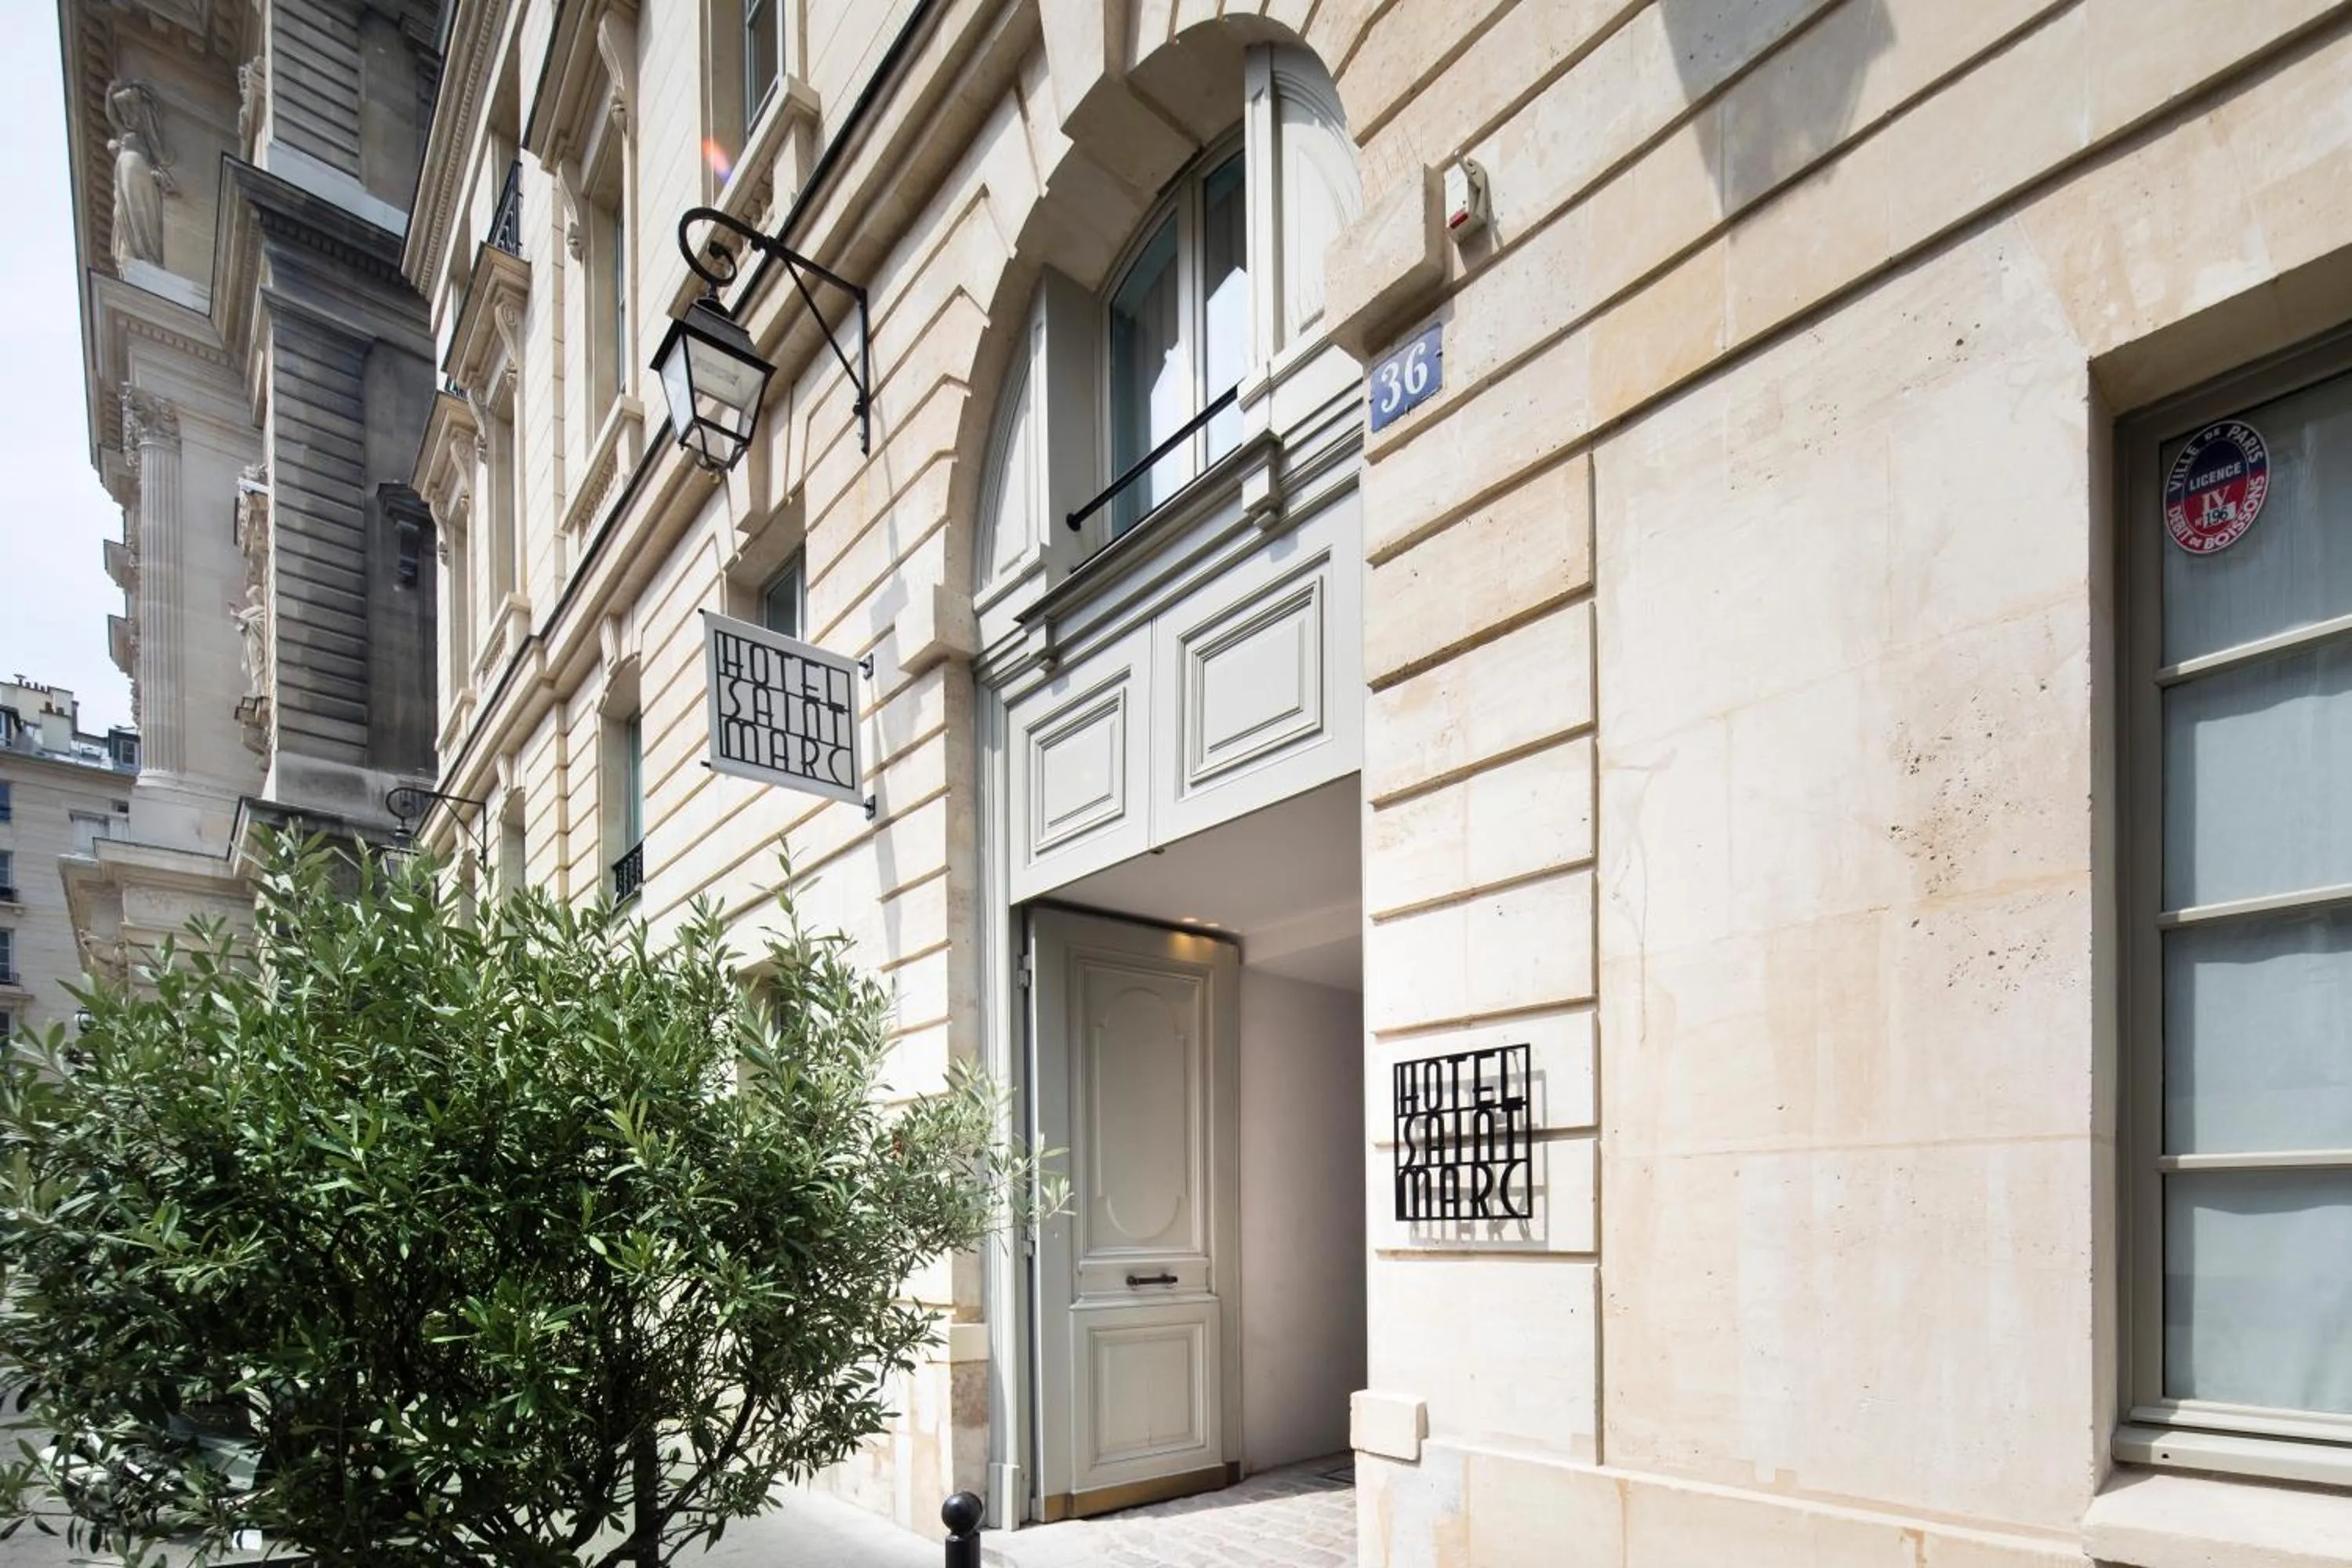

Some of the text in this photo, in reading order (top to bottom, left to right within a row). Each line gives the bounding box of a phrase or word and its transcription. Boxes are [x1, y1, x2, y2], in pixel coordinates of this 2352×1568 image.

[1381, 341, 1428, 413] 36
[2169, 445, 2200, 492] VILLE
[2227, 425, 2263, 463] PARIS
[2189, 461, 2241, 491] LICENCE
[2204, 475, 2265, 550] BOISSONS
[721, 631, 848, 714] HOTEL
[728, 677, 847, 746] SAINT
[724, 717, 853, 788] MARC
[1399, 1047, 1524, 1116] HOTEL
[1403, 1099, 1524, 1168] SAINT
[1397, 1160, 1529, 1219] MARC
